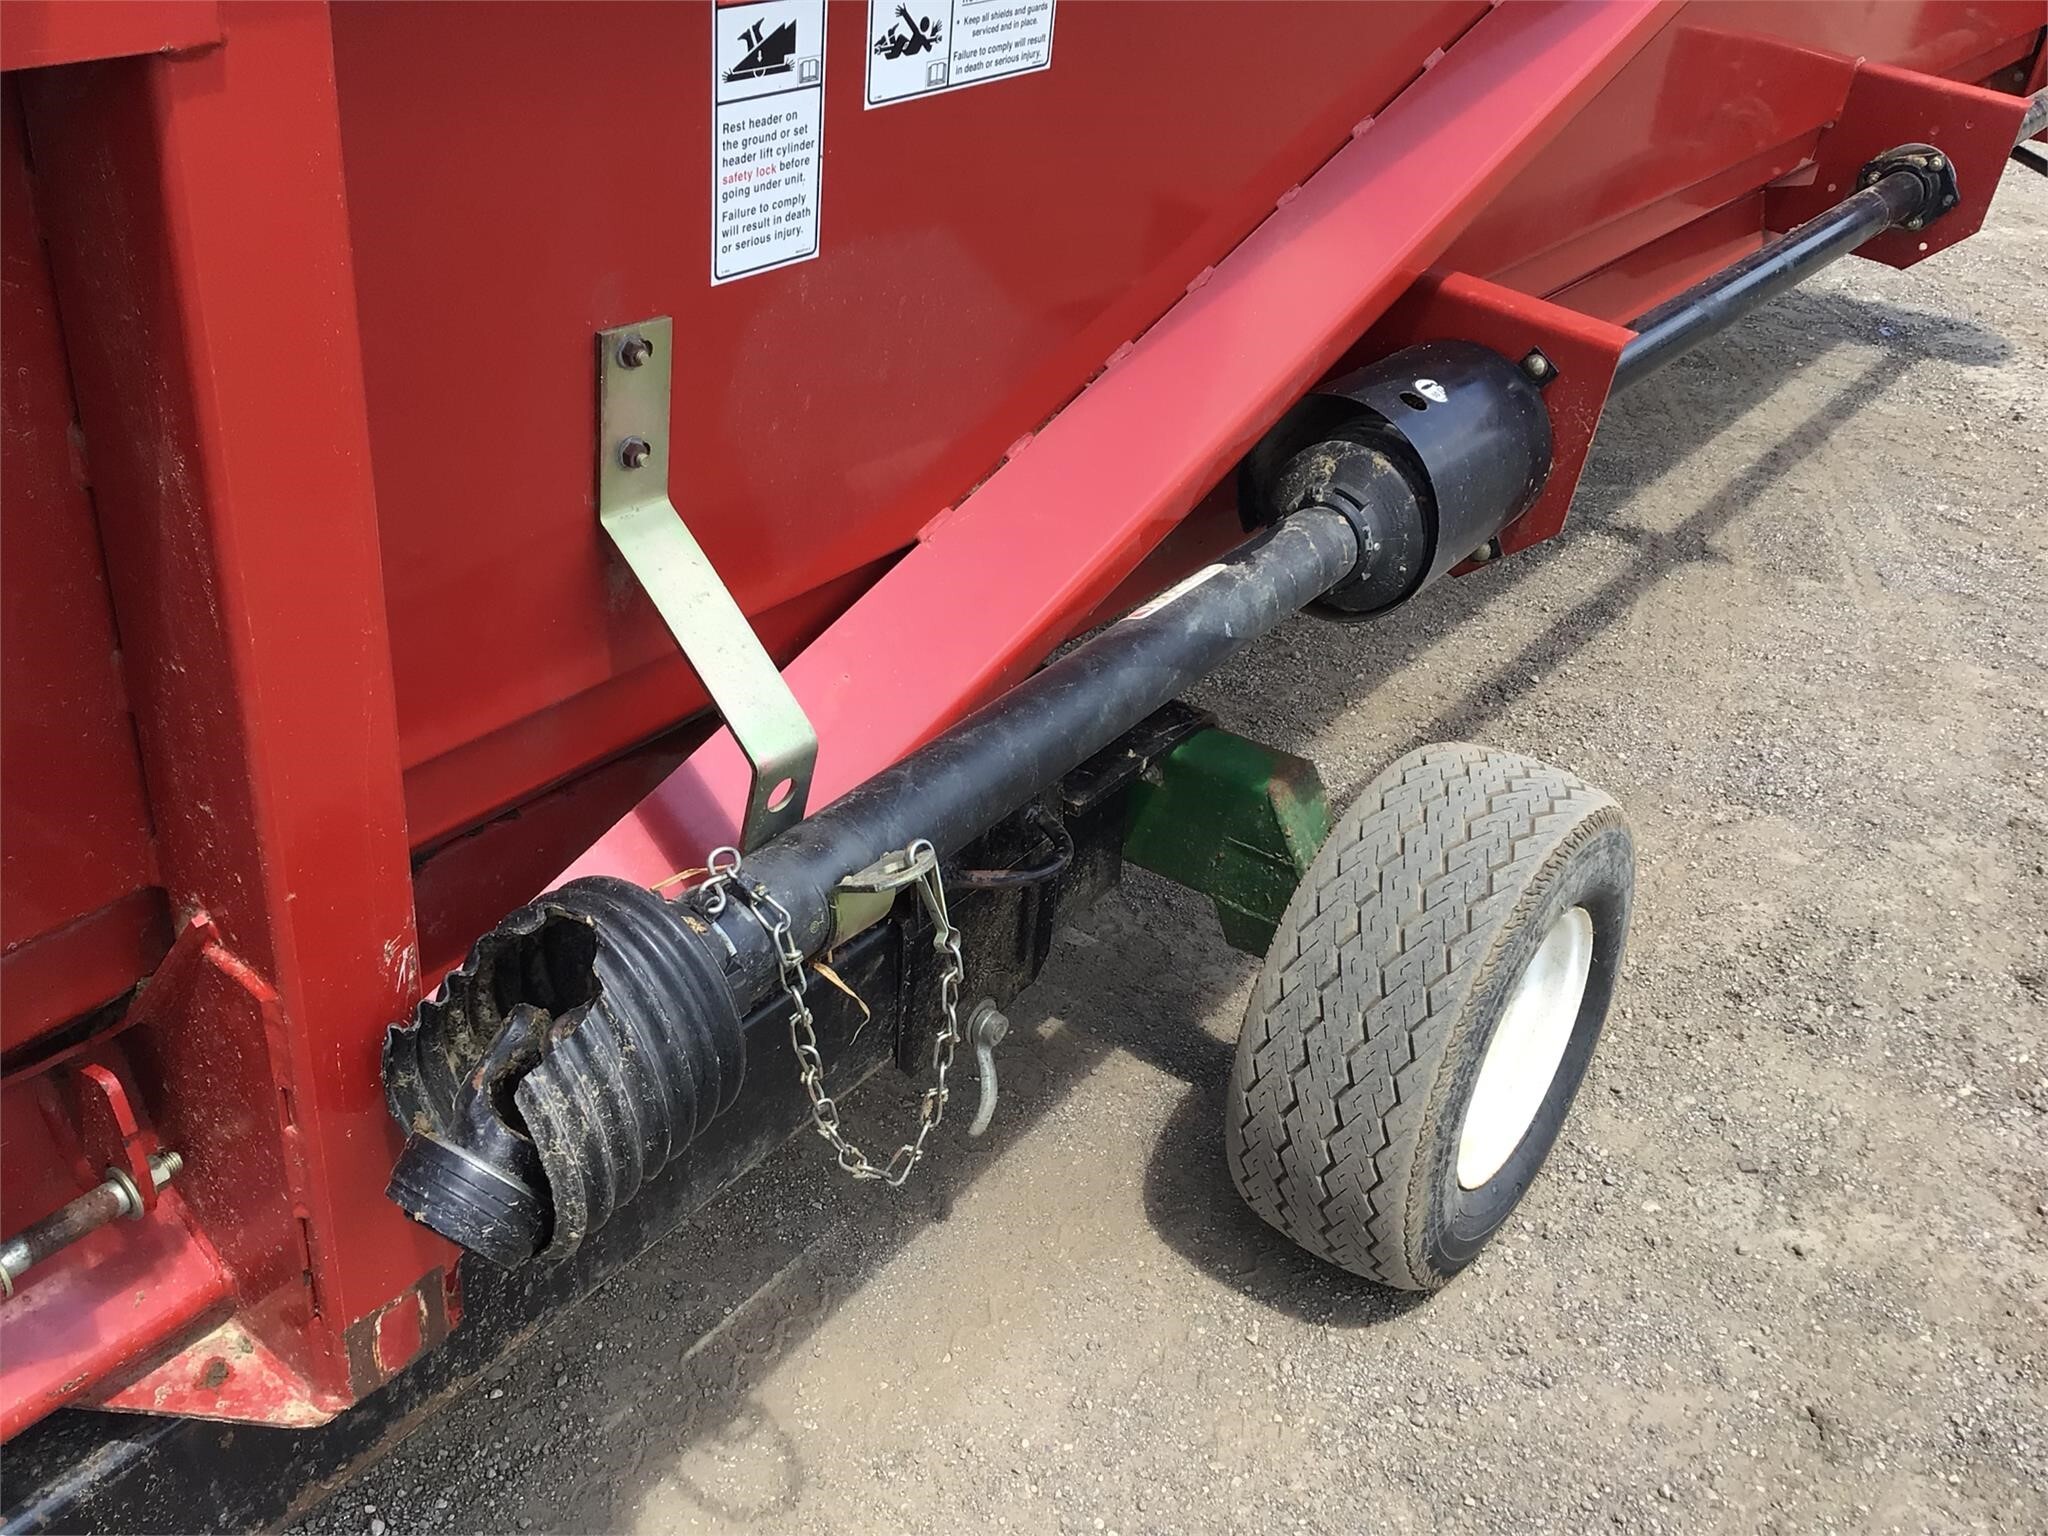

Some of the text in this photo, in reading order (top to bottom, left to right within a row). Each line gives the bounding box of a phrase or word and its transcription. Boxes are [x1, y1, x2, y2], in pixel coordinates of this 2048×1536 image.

[964, 2, 1048, 26] Keep all shields and guards
[972, 24, 999, 37] serviced
[1001, 21, 1012, 31] and
[1020, 17, 1038, 30] place.
[953, 34, 1046, 61] Failure to comply will result
[956, 66, 963, 74] in
[964, 60, 984, 73] death
[986, 58, 993, 67] or
[995, 54, 1019, 66] serious
[1021, 50, 1041, 62] injury.
[723, 111, 798, 134] Rest header on
[723, 125, 808, 151] the ground or set
[723, 139, 815, 167] header lift cylinder
[723, 156, 810, 185] safety lock before
[722, 173, 805, 202] going under unit.
[723, 193, 806, 222] Failure to comply
[722, 207, 811, 238] will result in death
[722, 226, 803, 254] or serious injury.
